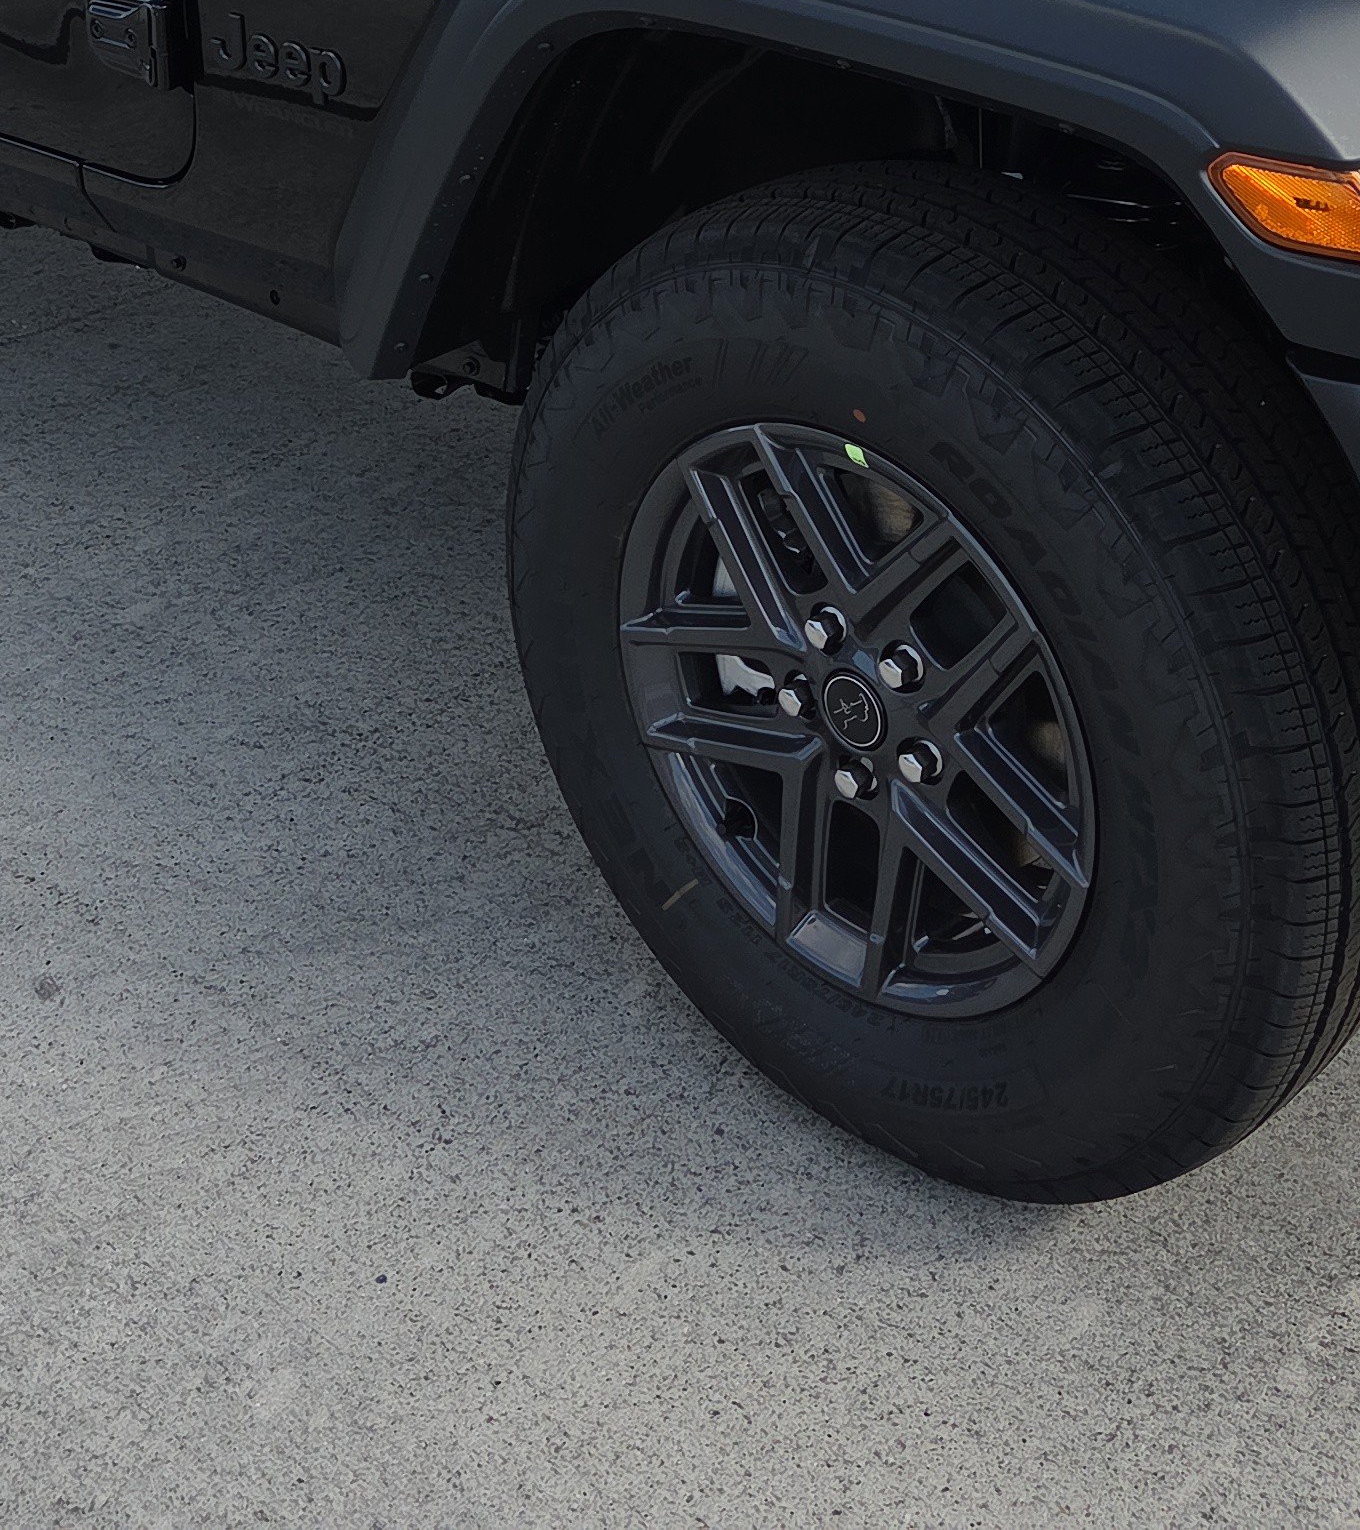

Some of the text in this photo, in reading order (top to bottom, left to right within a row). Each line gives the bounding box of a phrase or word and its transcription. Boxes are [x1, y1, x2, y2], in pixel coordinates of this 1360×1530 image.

[209, 11, 347, 105] Jeep
[589, 356, 694, 441] All-Weather
[928, 441, 1142, 756] ROADIAN
[879, 1067, 1013, 1112] 245/75R17
